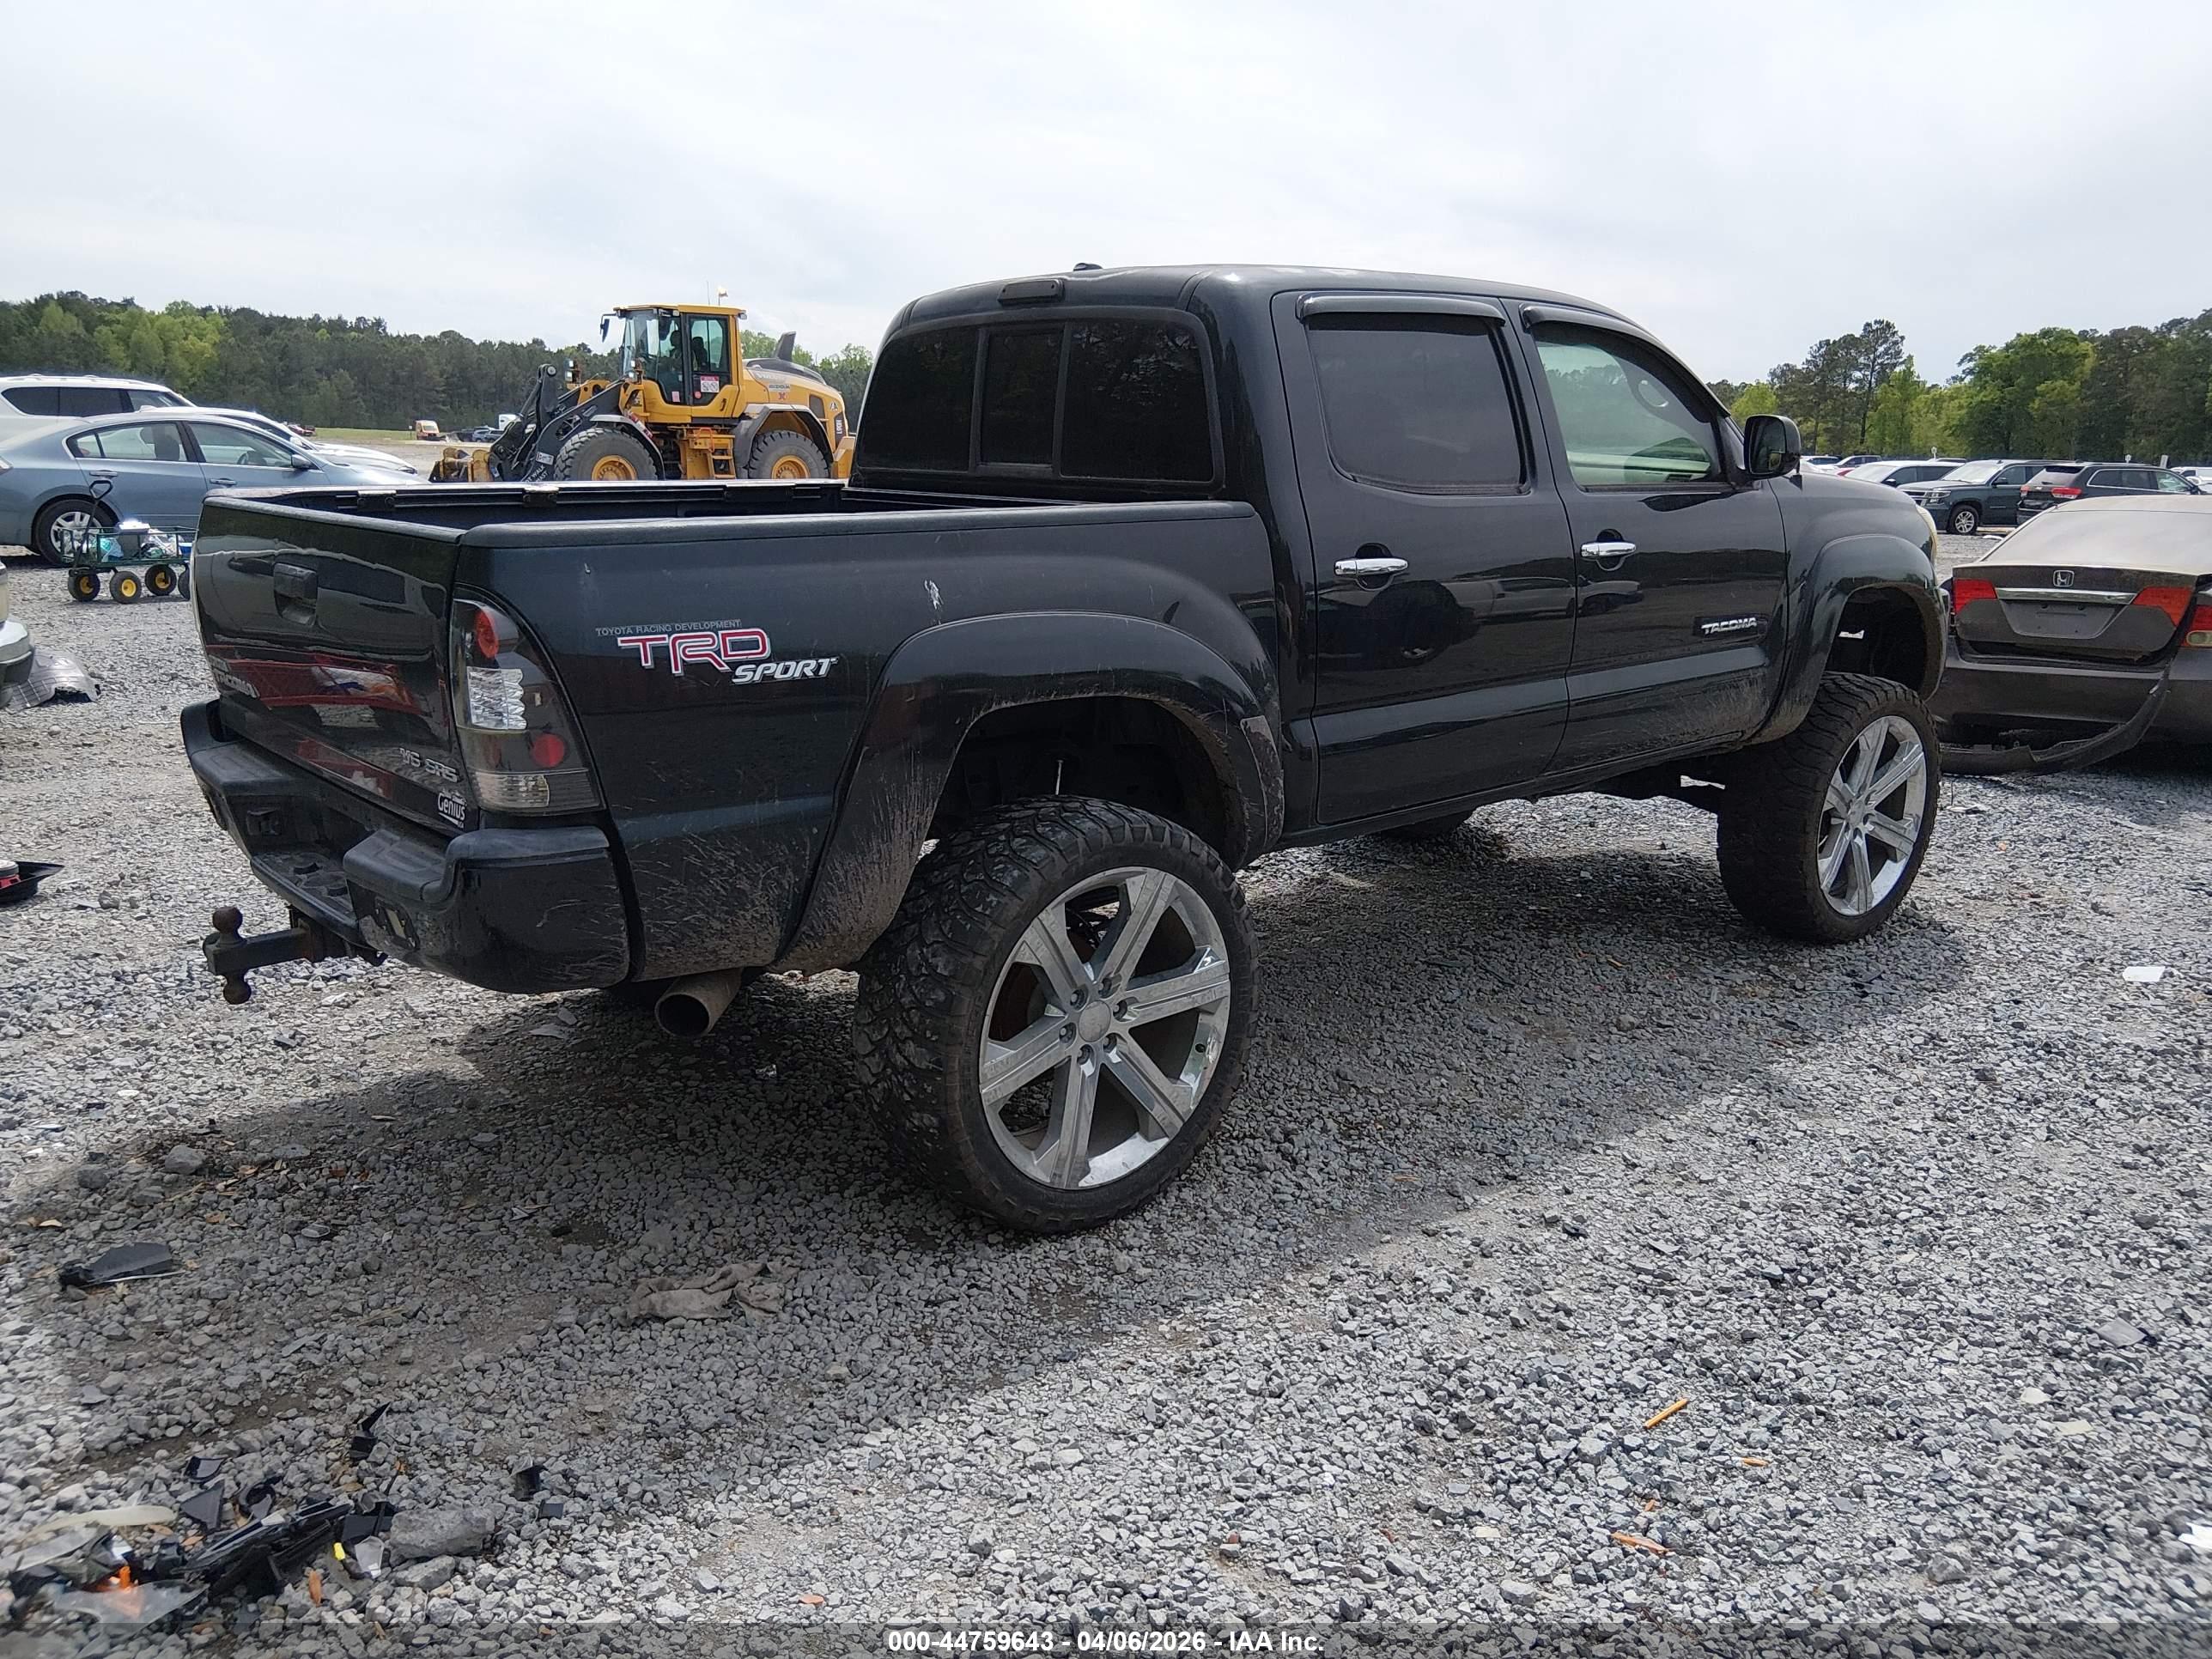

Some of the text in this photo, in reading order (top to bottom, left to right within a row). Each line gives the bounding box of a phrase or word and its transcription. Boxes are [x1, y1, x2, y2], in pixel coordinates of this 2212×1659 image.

[595, 618, 743, 637] TOYOTA RACING DEVELOPMENT
[1701, 617, 1758, 635] TACOMA
[617, 628, 771, 677] TRD
[732, 656, 840, 684] SPORT
[437, 792, 465, 821] Genius
